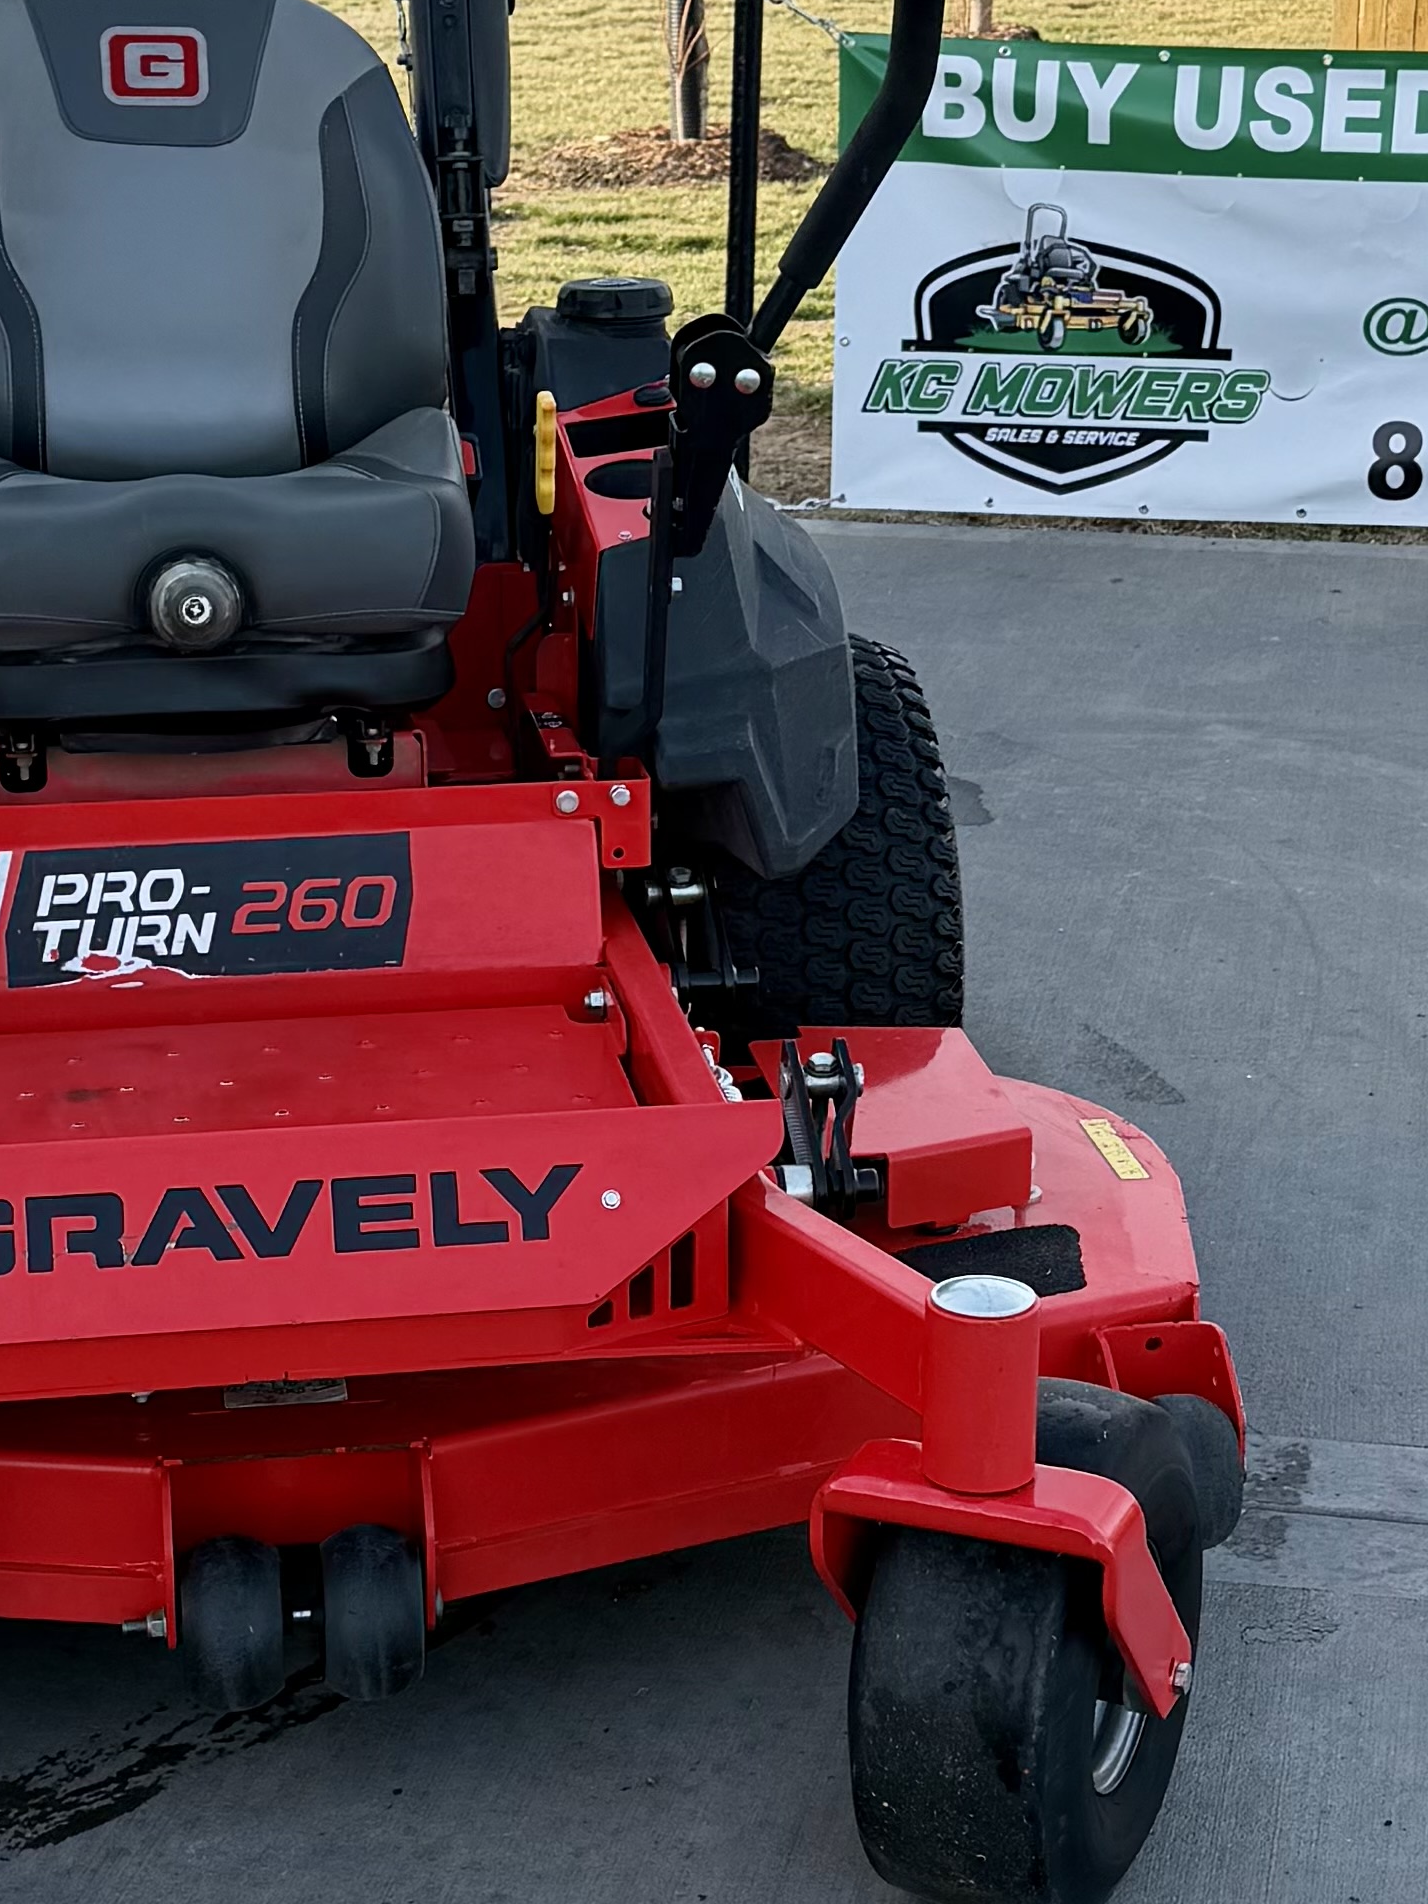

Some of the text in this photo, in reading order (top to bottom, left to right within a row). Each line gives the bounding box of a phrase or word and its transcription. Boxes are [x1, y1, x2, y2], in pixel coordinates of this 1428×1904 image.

[922, 54, 1140, 145] BUY
[861, 359, 1270, 423] KC MOWERS
[985, 428, 1140, 446] SALES & SERVICE
[36, 869, 398, 934] PRO- 260
[32, 912, 217, 964] TURN
